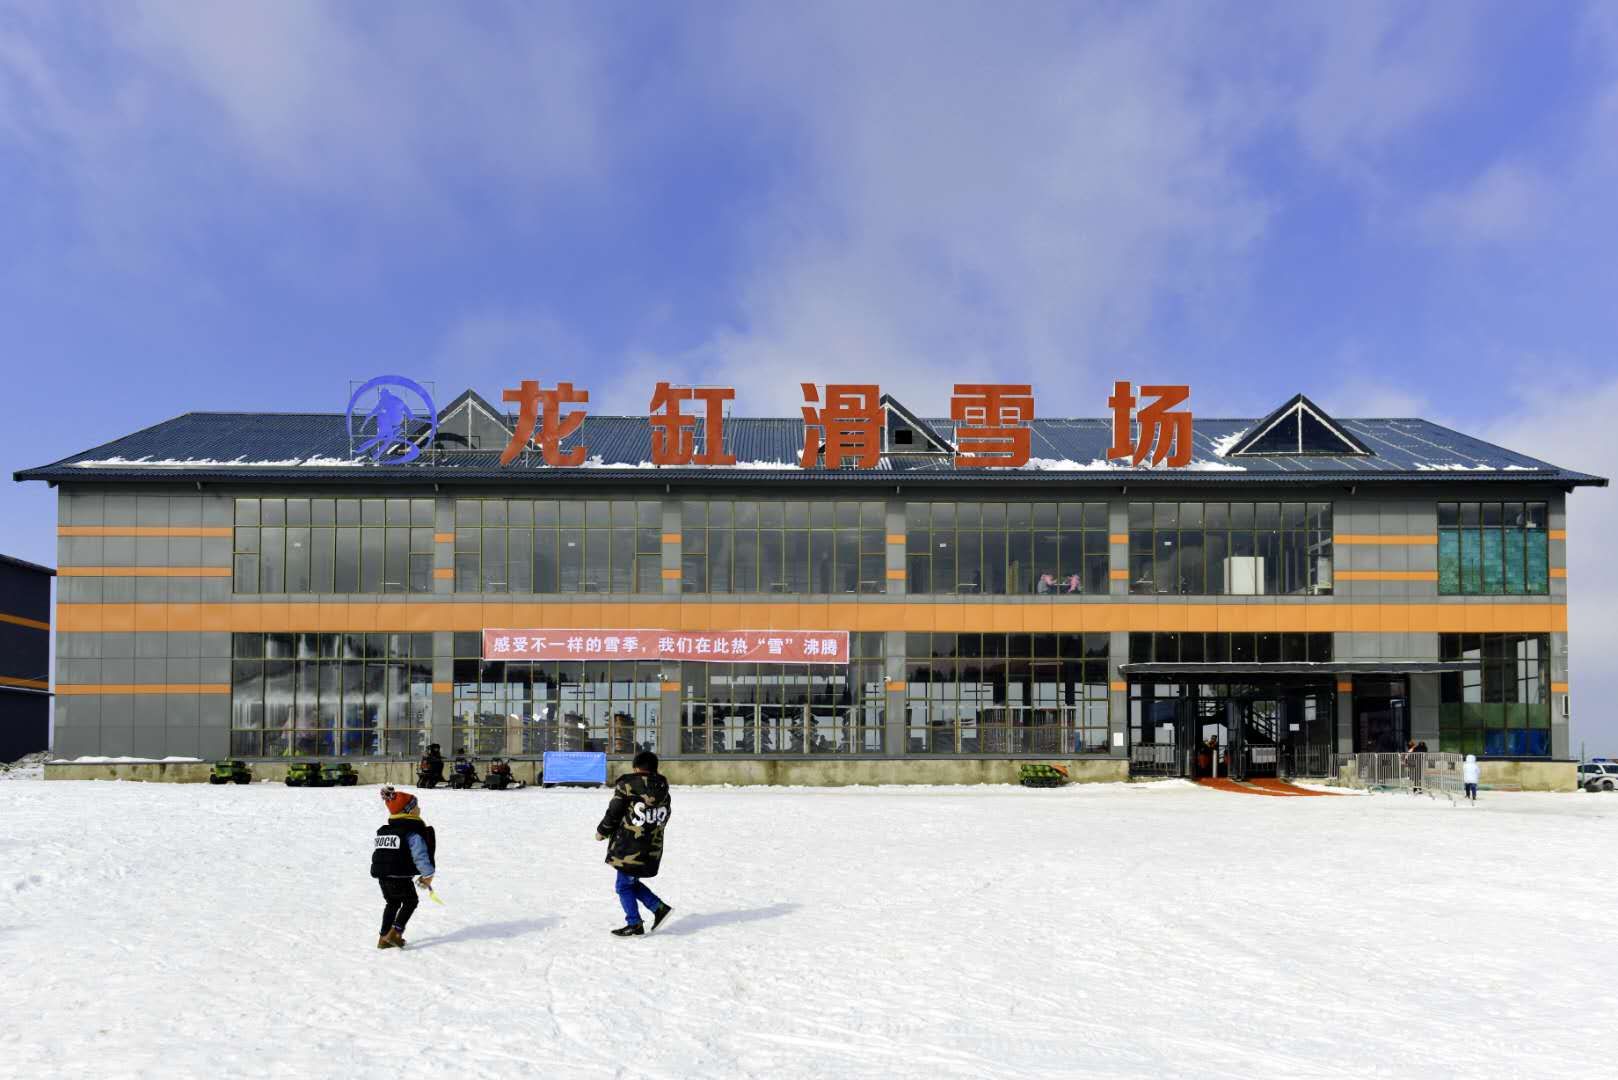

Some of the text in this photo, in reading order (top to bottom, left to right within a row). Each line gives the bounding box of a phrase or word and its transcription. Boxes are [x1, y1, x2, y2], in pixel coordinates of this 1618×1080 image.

[501, 380, 1193, 470] 龙缸滑雪场
